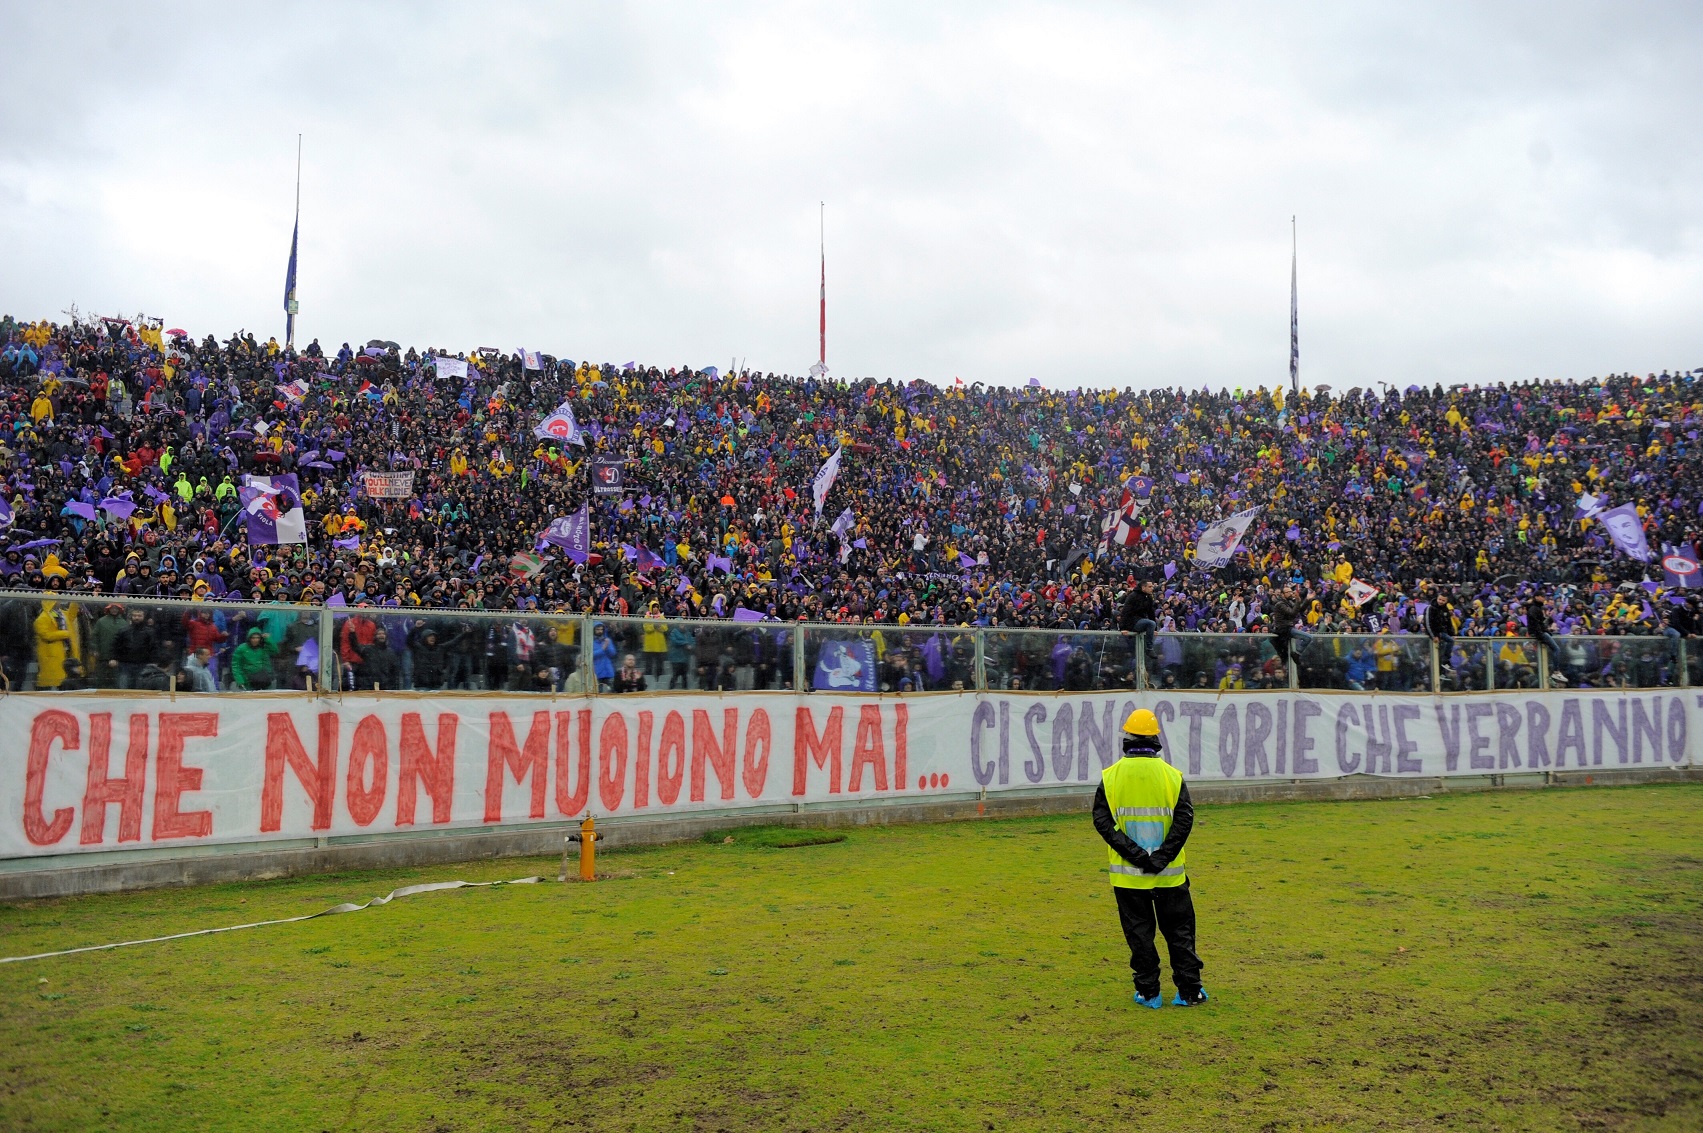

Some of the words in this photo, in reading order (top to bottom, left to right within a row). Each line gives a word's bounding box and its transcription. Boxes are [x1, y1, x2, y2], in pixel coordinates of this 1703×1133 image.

[367, 487, 385, 496] ALK
[385, 487, 409, 496] ALONE
[257, 512, 273, 527] VIOLA
[23, 710, 219, 846] CHE
[260, 711, 460, 833] NON
[483, 705, 771, 824] MUOIONO
[792, 703, 949, 797] MAI...
[971, 700, 1009, 785] CI
[1154, 700, 1322, 777] STORIE
[1336, 702, 1424, 774] CHE
[1434, 696, 1687, 771] VERRANNO
